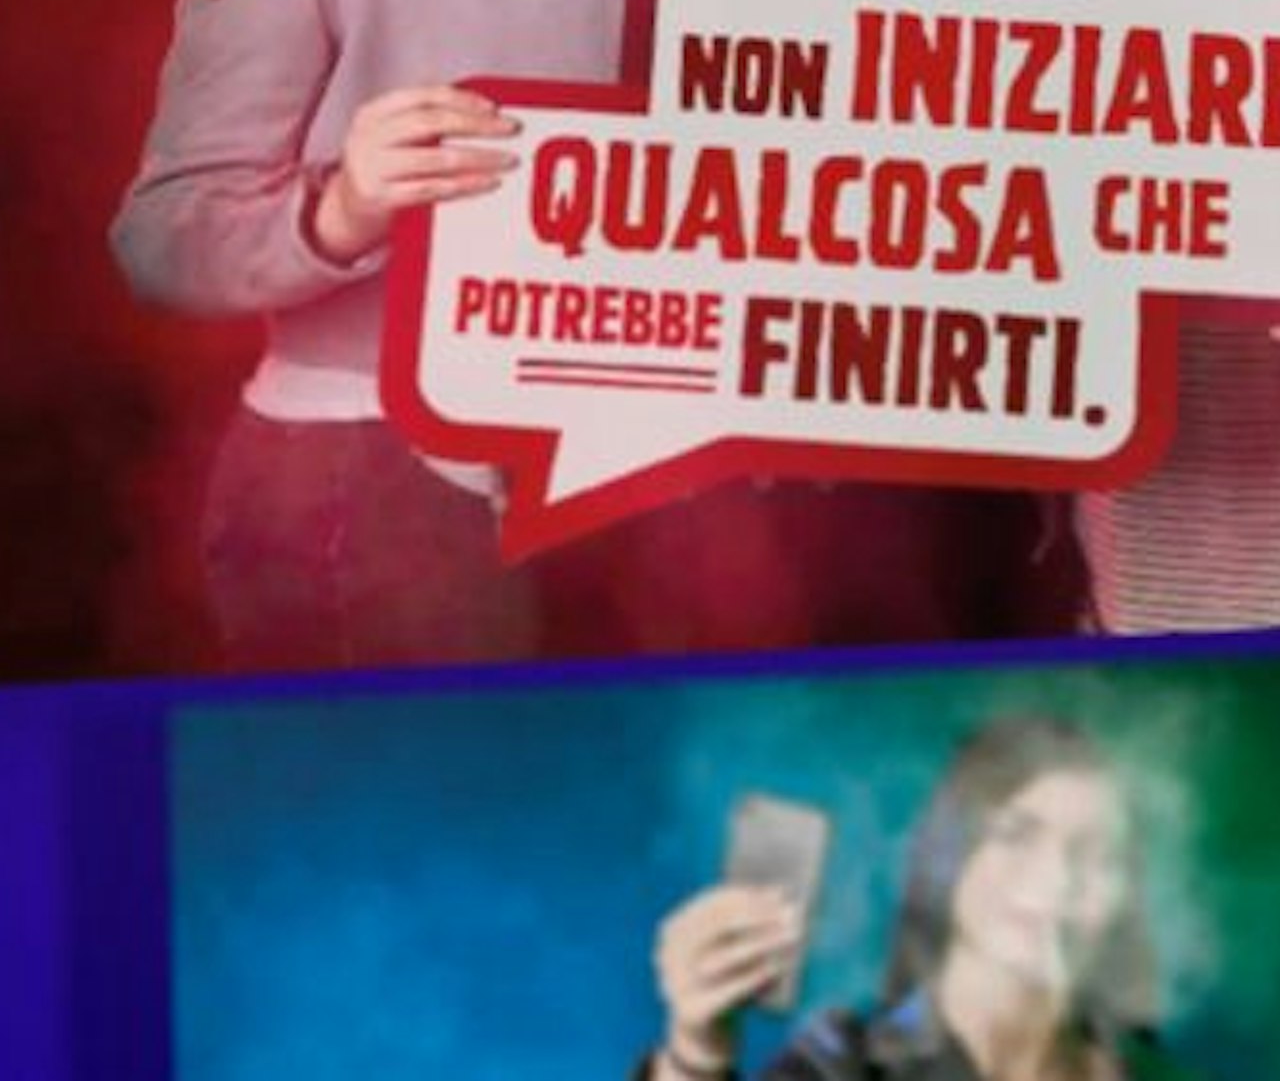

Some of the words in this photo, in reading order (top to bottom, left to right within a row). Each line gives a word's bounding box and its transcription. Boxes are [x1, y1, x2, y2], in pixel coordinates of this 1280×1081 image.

[680, 35, 828, 118] NON
[530, 136, 1062, 283] QUALCOSA
[1095, 176, 1229, 259] CHE
[455, 277, 722, 351] POTREBBE
[738, 298, 1108, 427] FINIRTI.
